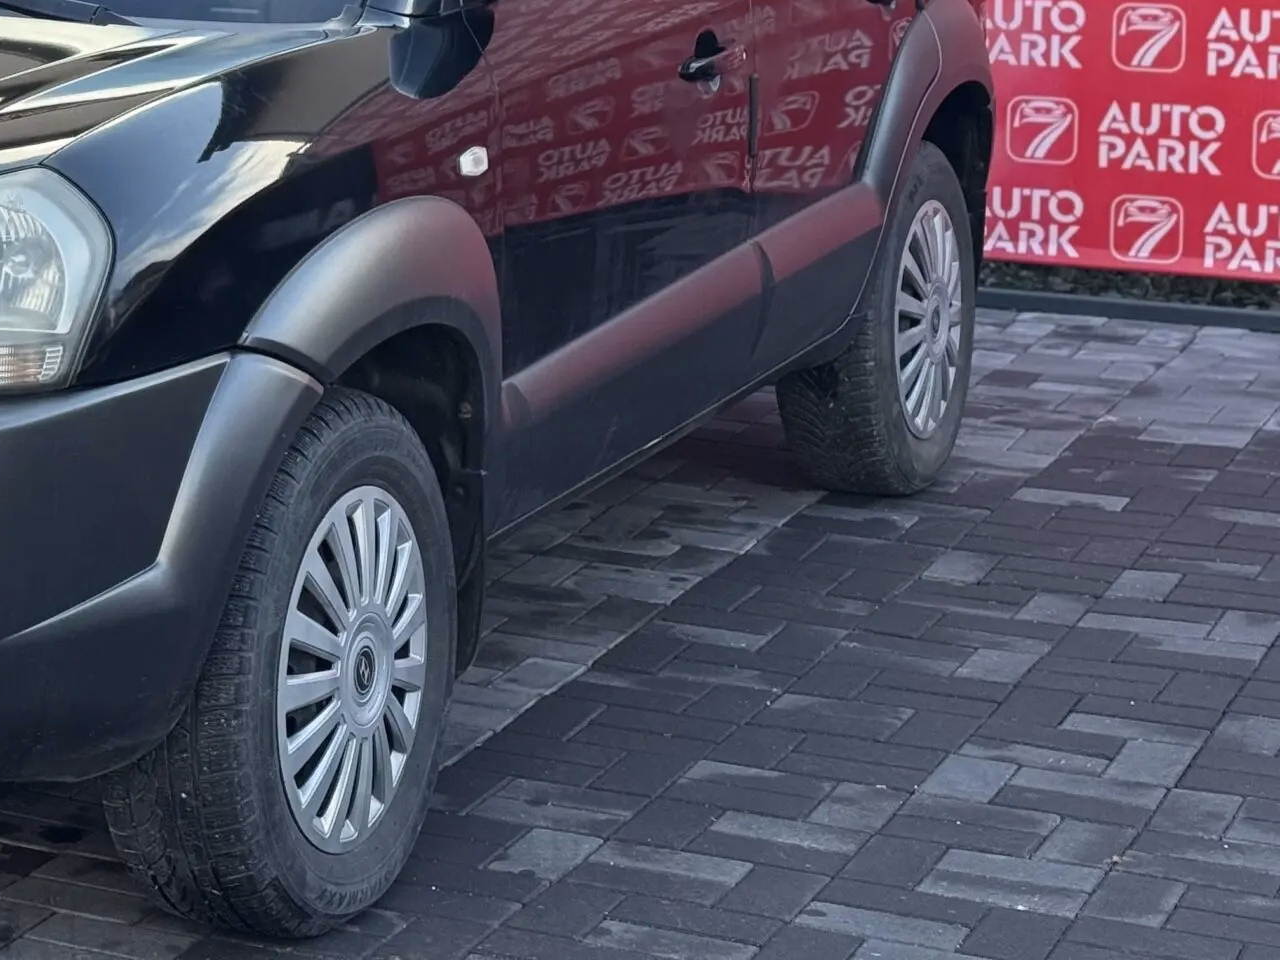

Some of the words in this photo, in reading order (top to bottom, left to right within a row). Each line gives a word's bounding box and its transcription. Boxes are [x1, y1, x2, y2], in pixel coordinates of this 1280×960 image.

[988, 32, 1082, 69] ARK
[1098, 101, 1225, 139] AUTO
[1099, 135, 1221, 175] PARK
[985, 186, 1084, 224] UTO
[984, 221, 1081, 258] ARK
